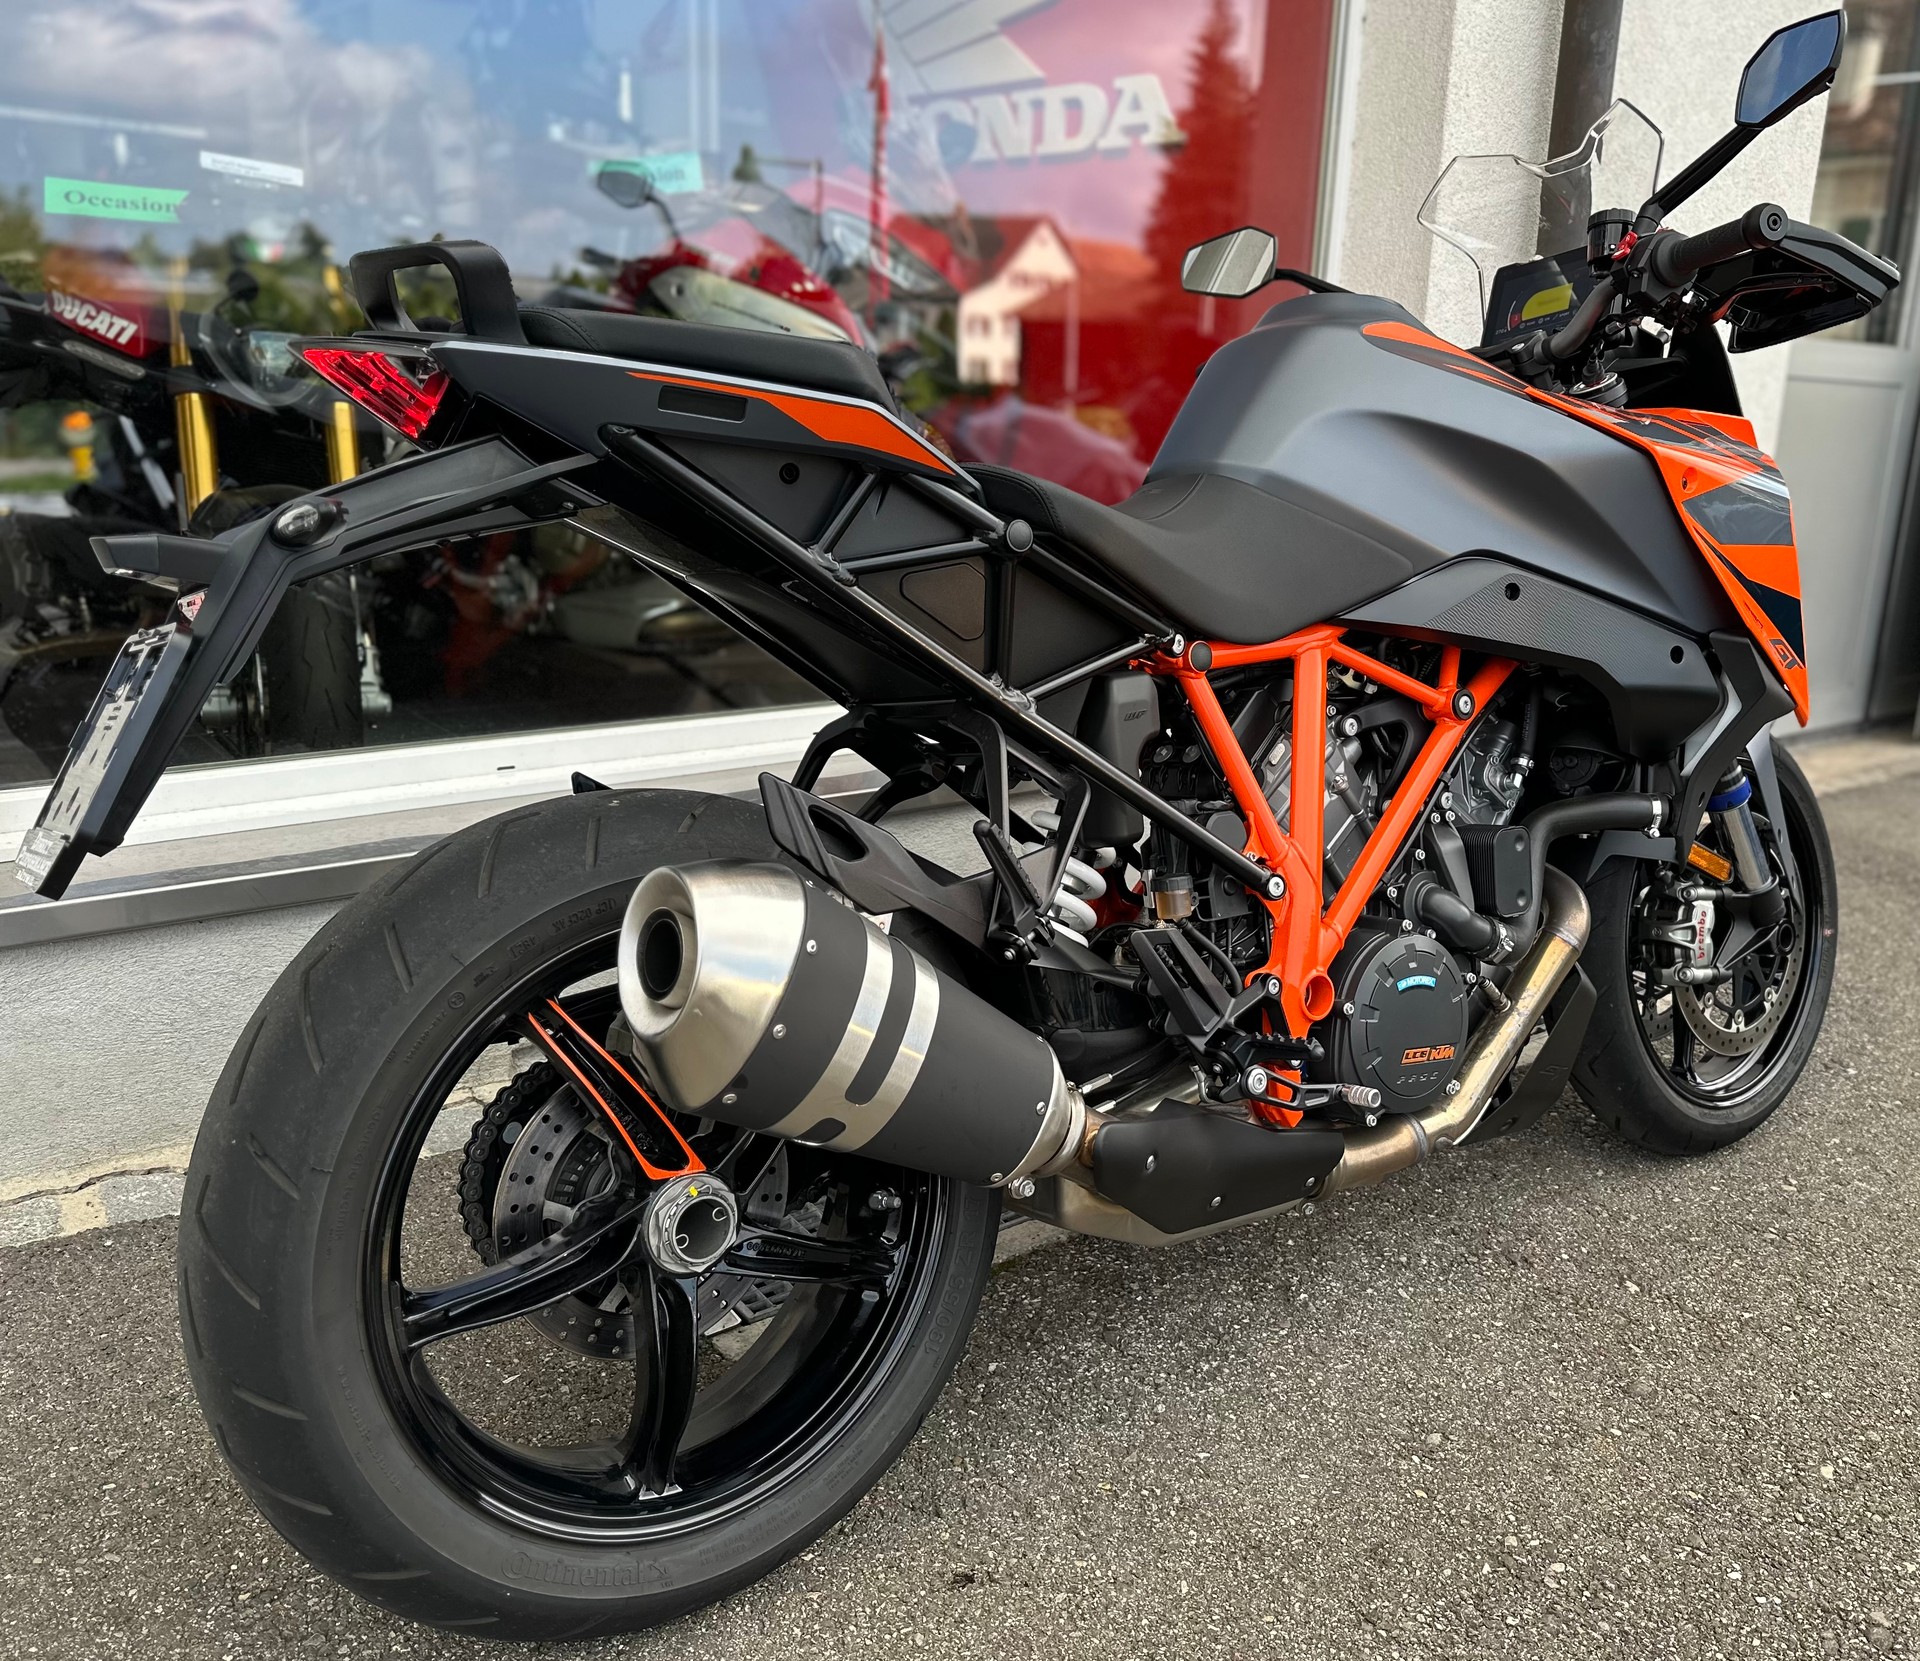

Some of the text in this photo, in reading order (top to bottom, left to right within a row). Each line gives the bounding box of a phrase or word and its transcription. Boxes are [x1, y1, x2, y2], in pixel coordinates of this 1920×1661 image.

[62, 188, 178, 214] Occasion
[51, 289, 139, 346] DUCATI
[1697, 910, 1707, 960] brembo
[1430, 1044, 1455, 1060] KTM
[963, 1195, 981, 1217] 17
[954, 1230, 977, 1266] ZR
[925, 1272, 966, 1354] 190/55
[501, 1551, 647, 1588] Continental
